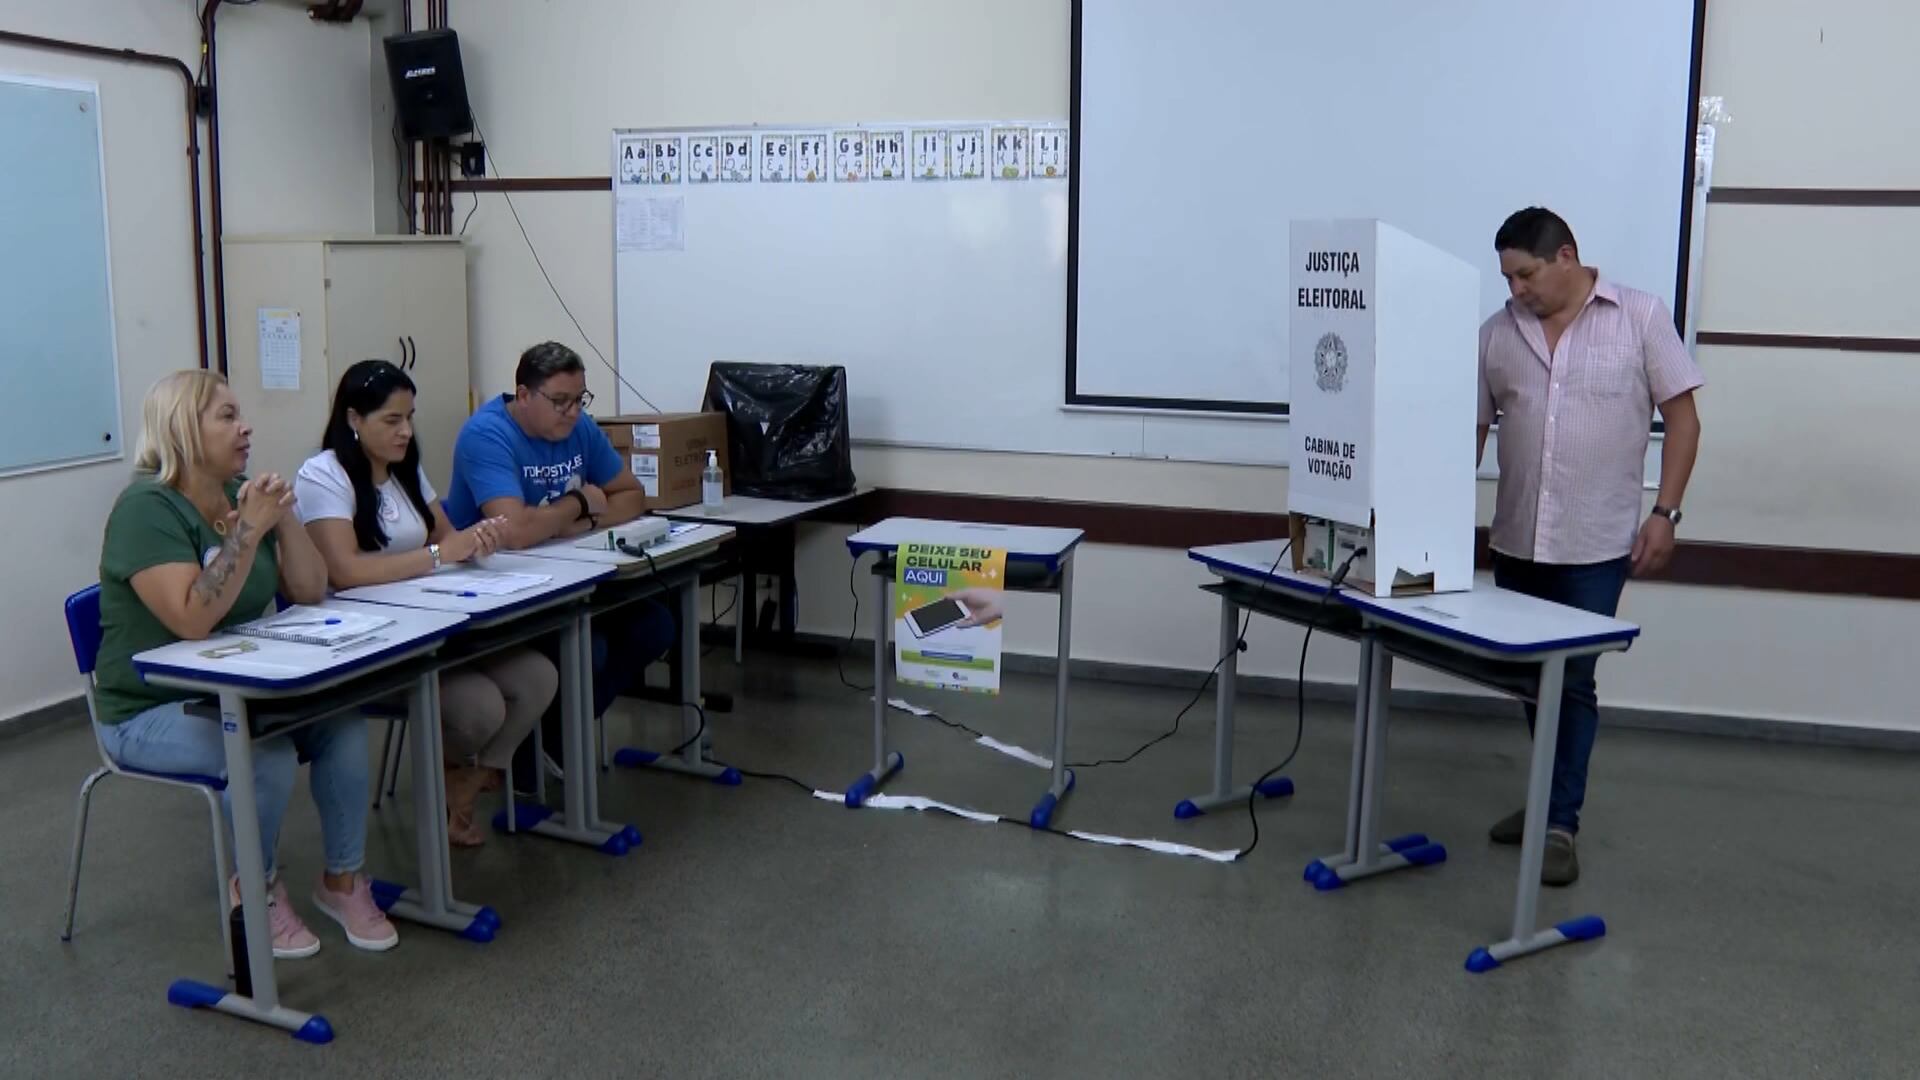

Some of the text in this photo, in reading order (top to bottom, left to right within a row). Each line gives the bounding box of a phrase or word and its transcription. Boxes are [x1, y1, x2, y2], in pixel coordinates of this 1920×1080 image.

[1305, 251, 1360, 278] JUSTIÇA
[1298, 287, 1367, 310] ELEITORAL
[1304, 436, 1356, 459] CABINA DE
[1307, 457, 1352, 481] VOTAÇÃO
[907, 544, 992, 560] DEIXE SEU
[906, 556, 983, 572] CELULAR
[905, 569, 943, 584] AQUI
